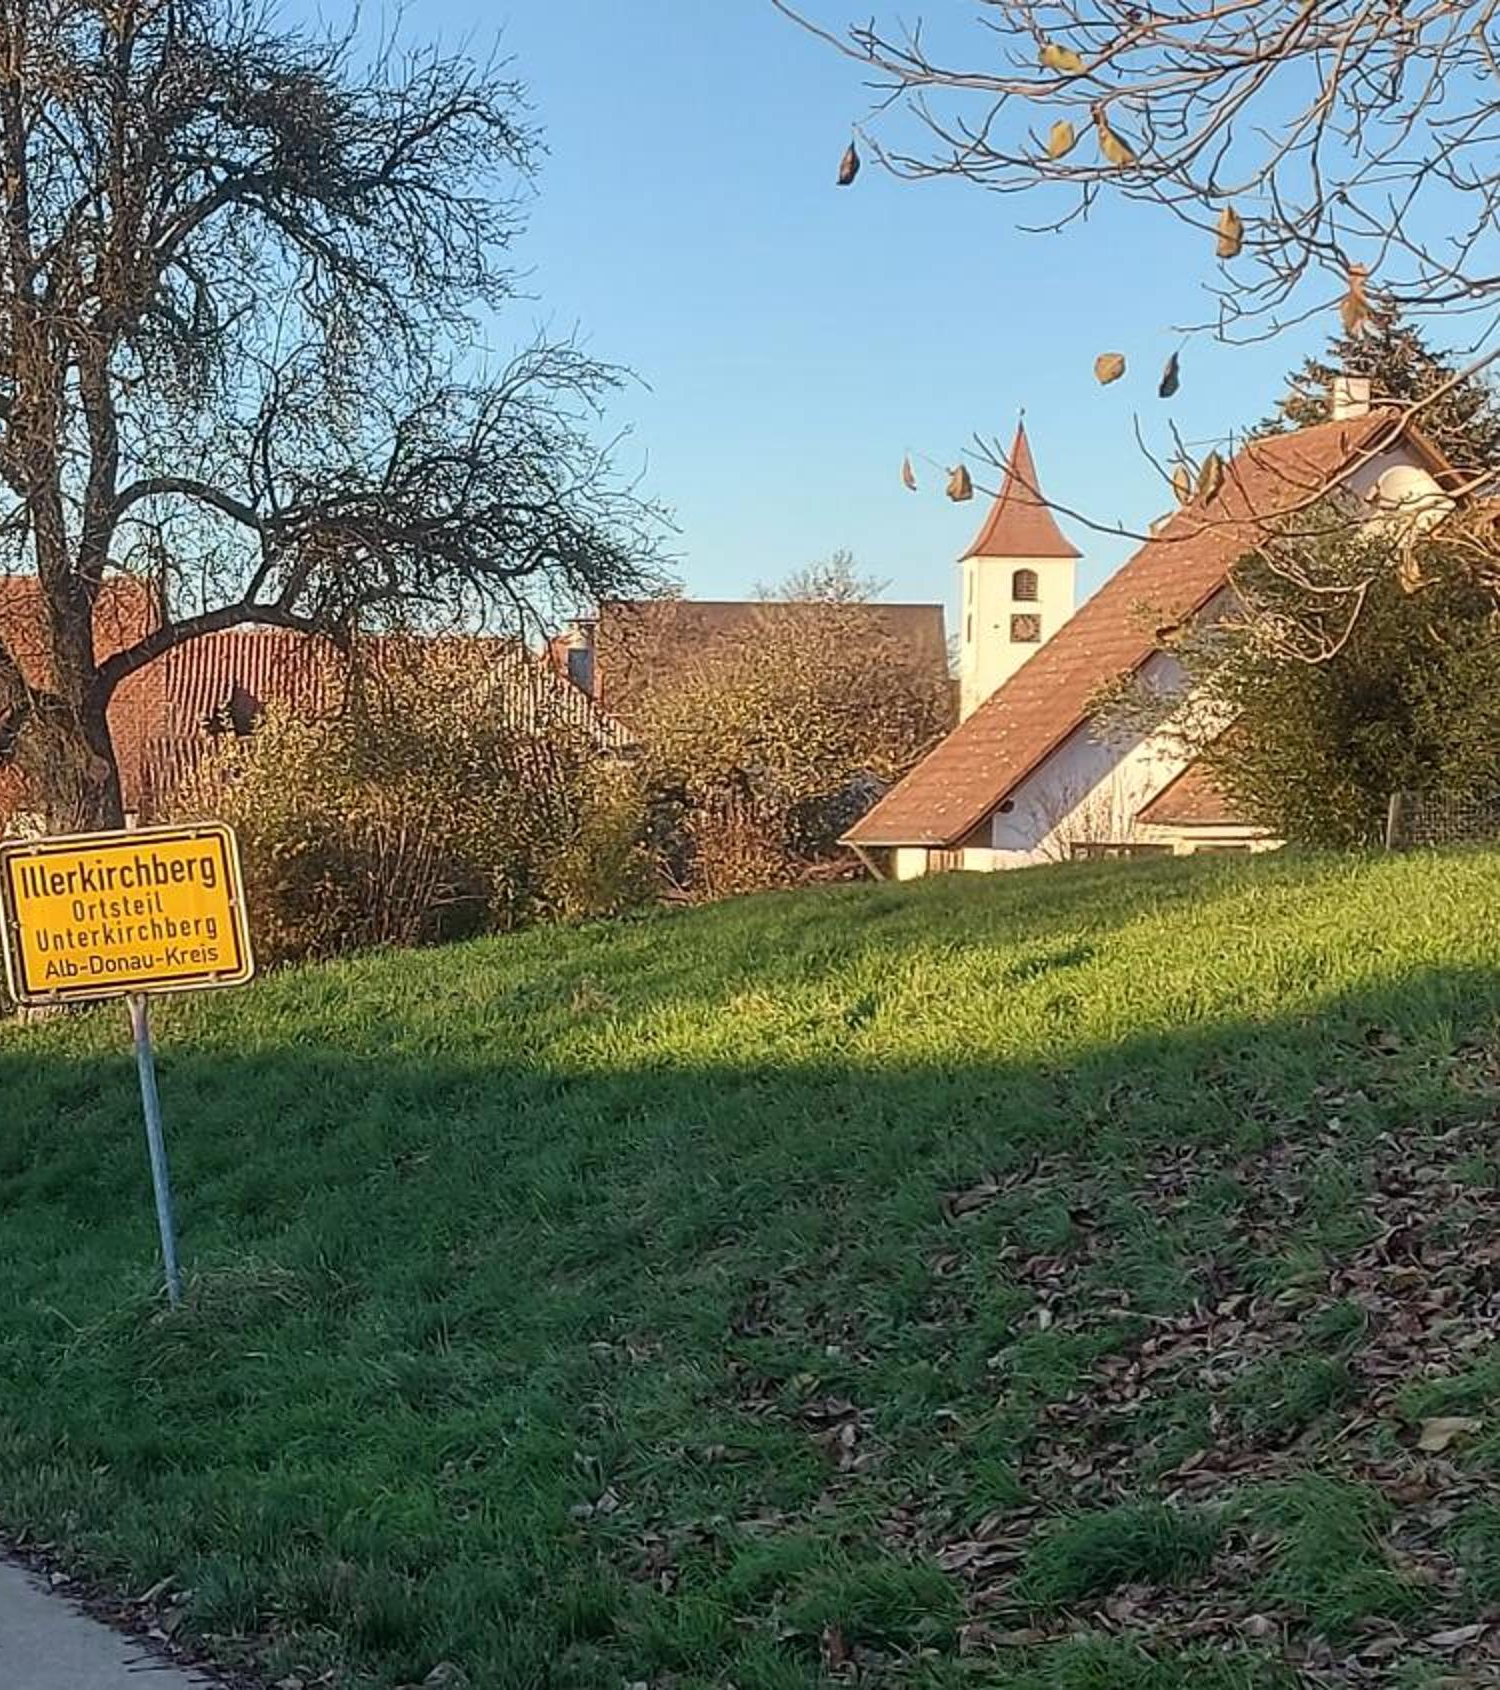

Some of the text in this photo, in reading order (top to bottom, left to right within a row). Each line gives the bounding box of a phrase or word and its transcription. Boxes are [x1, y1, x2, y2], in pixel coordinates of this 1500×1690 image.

[20, 853, 217, 899] Illerkirchberg
[72, 891, 164, 922] Ortsteil
[35, 917, 218, 952] Unterkirchberg
[45, 944, 219, 980] Alb-Donau-Kreis
